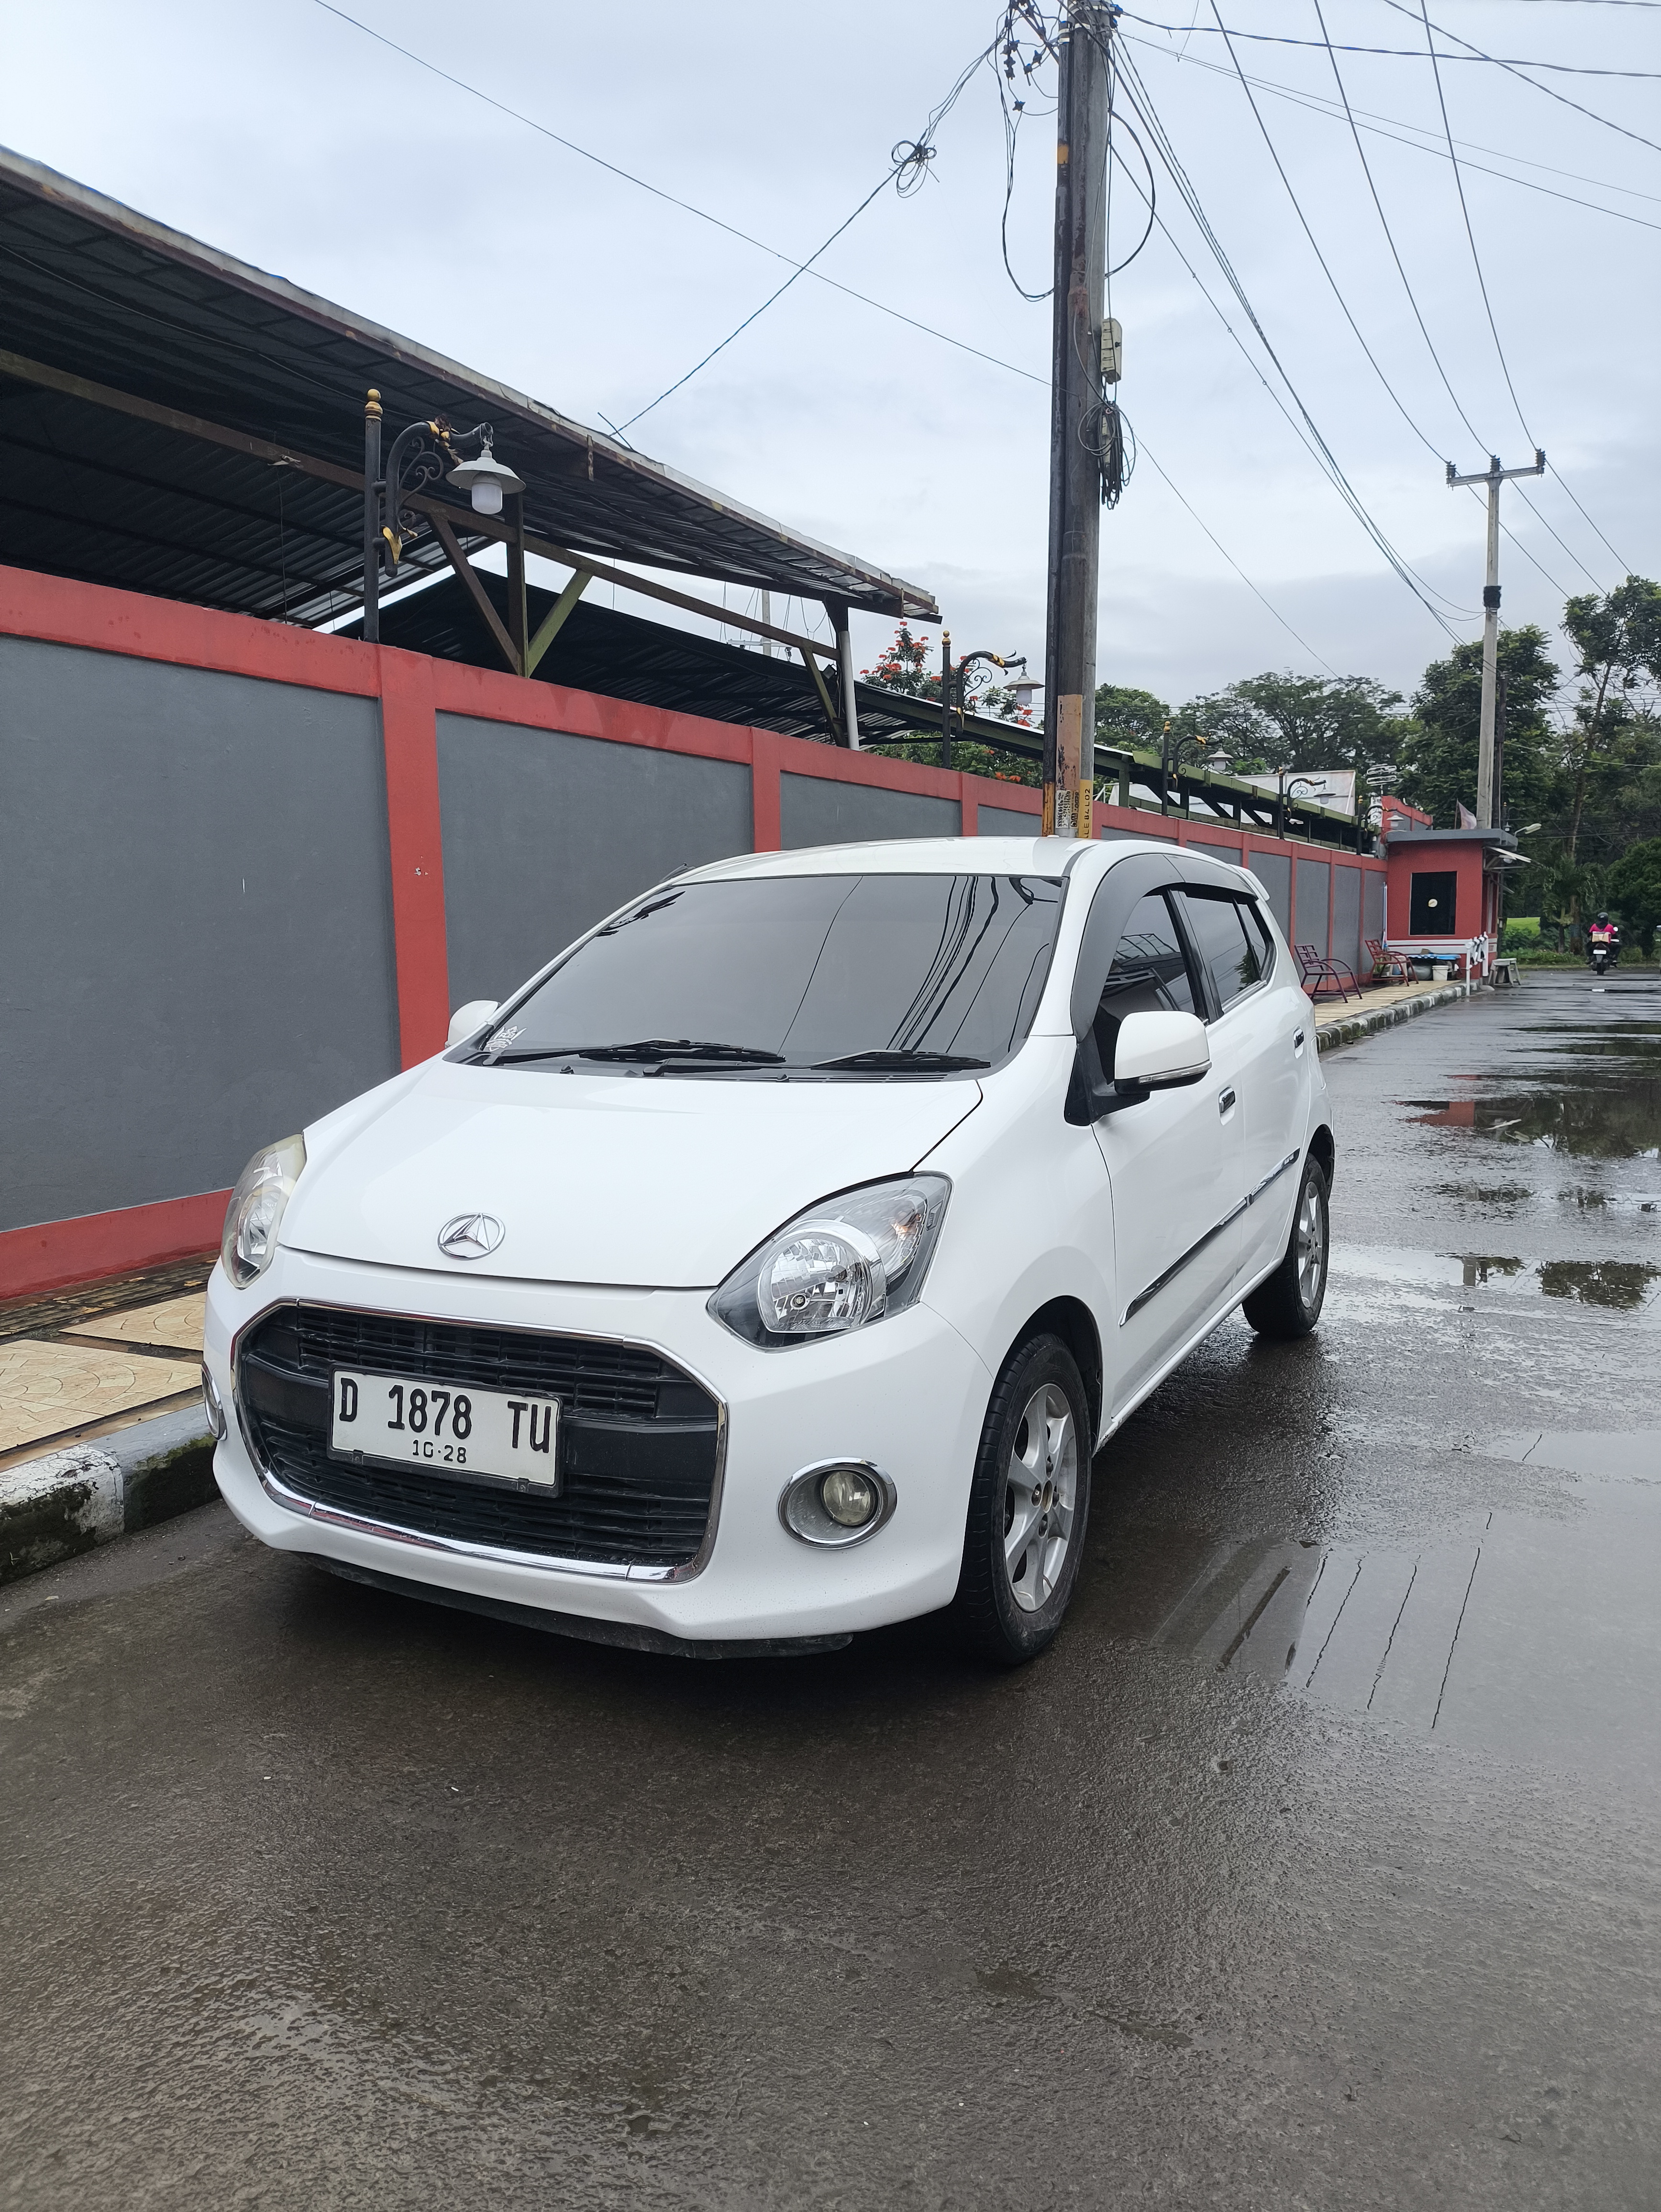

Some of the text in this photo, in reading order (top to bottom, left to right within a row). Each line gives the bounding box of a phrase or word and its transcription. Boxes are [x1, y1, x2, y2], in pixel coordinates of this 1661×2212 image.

[339, 1378, 551, 1453] D 1878 TU
